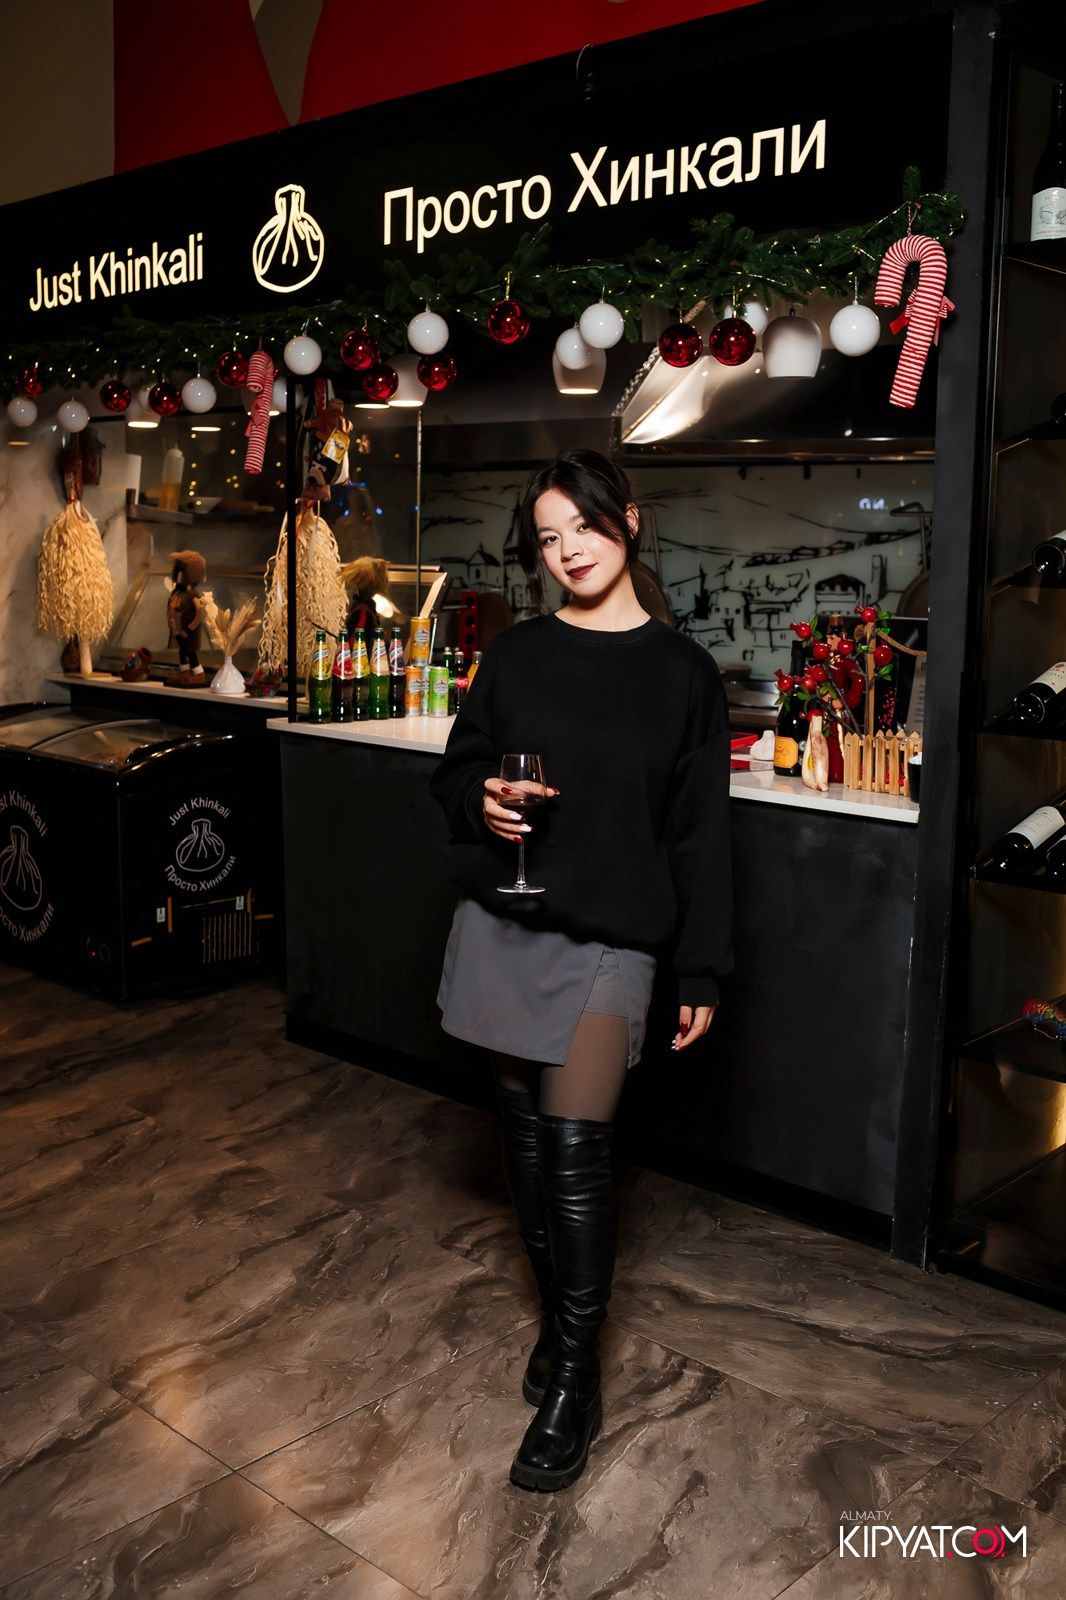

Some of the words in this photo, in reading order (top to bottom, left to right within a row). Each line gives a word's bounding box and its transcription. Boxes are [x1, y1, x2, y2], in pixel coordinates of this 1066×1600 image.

[383, 174, 552, 254] Просто
[567, 119, 827, 213] Хинкали
[29, 261, 83, 313] Just
[89, 232, 205, 300] Khinkali
[9, 789, 48, 838] Khinkali
[168, 802, 190, 826] Just
[190, 796, 232, 819] Khinkali
[164, 863, 198, 892] Просто
[199, 855, 237, 891] Хинкали
[18, 902, 55, 943] Хинкали
